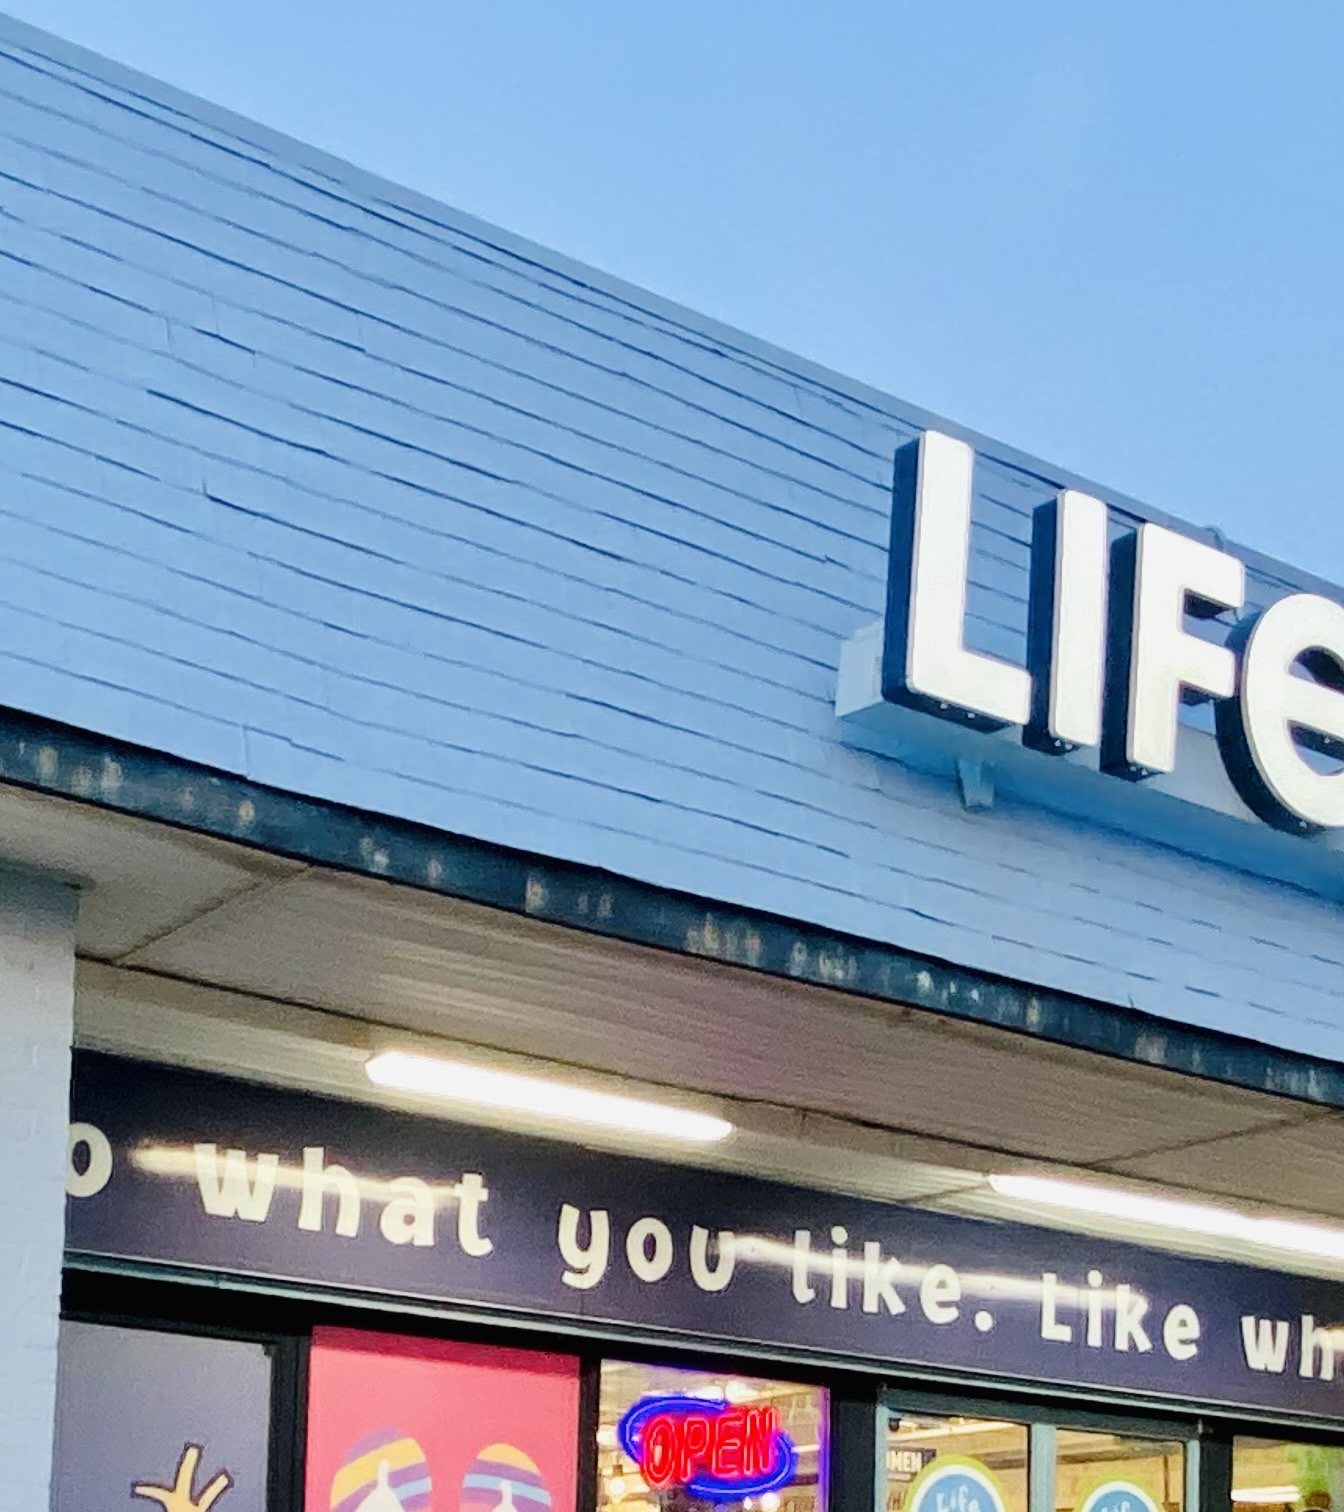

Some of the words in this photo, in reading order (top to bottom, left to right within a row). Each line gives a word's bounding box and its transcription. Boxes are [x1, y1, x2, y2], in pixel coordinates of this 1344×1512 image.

[194, 1143, 494, 1257] what
[556, 1203, 737, 1290] you
[790, 1225, 993, 1332] like.
[1039, 1270, 1200, 1361] Like
[641, 1407, 778, 1488] OPEN
